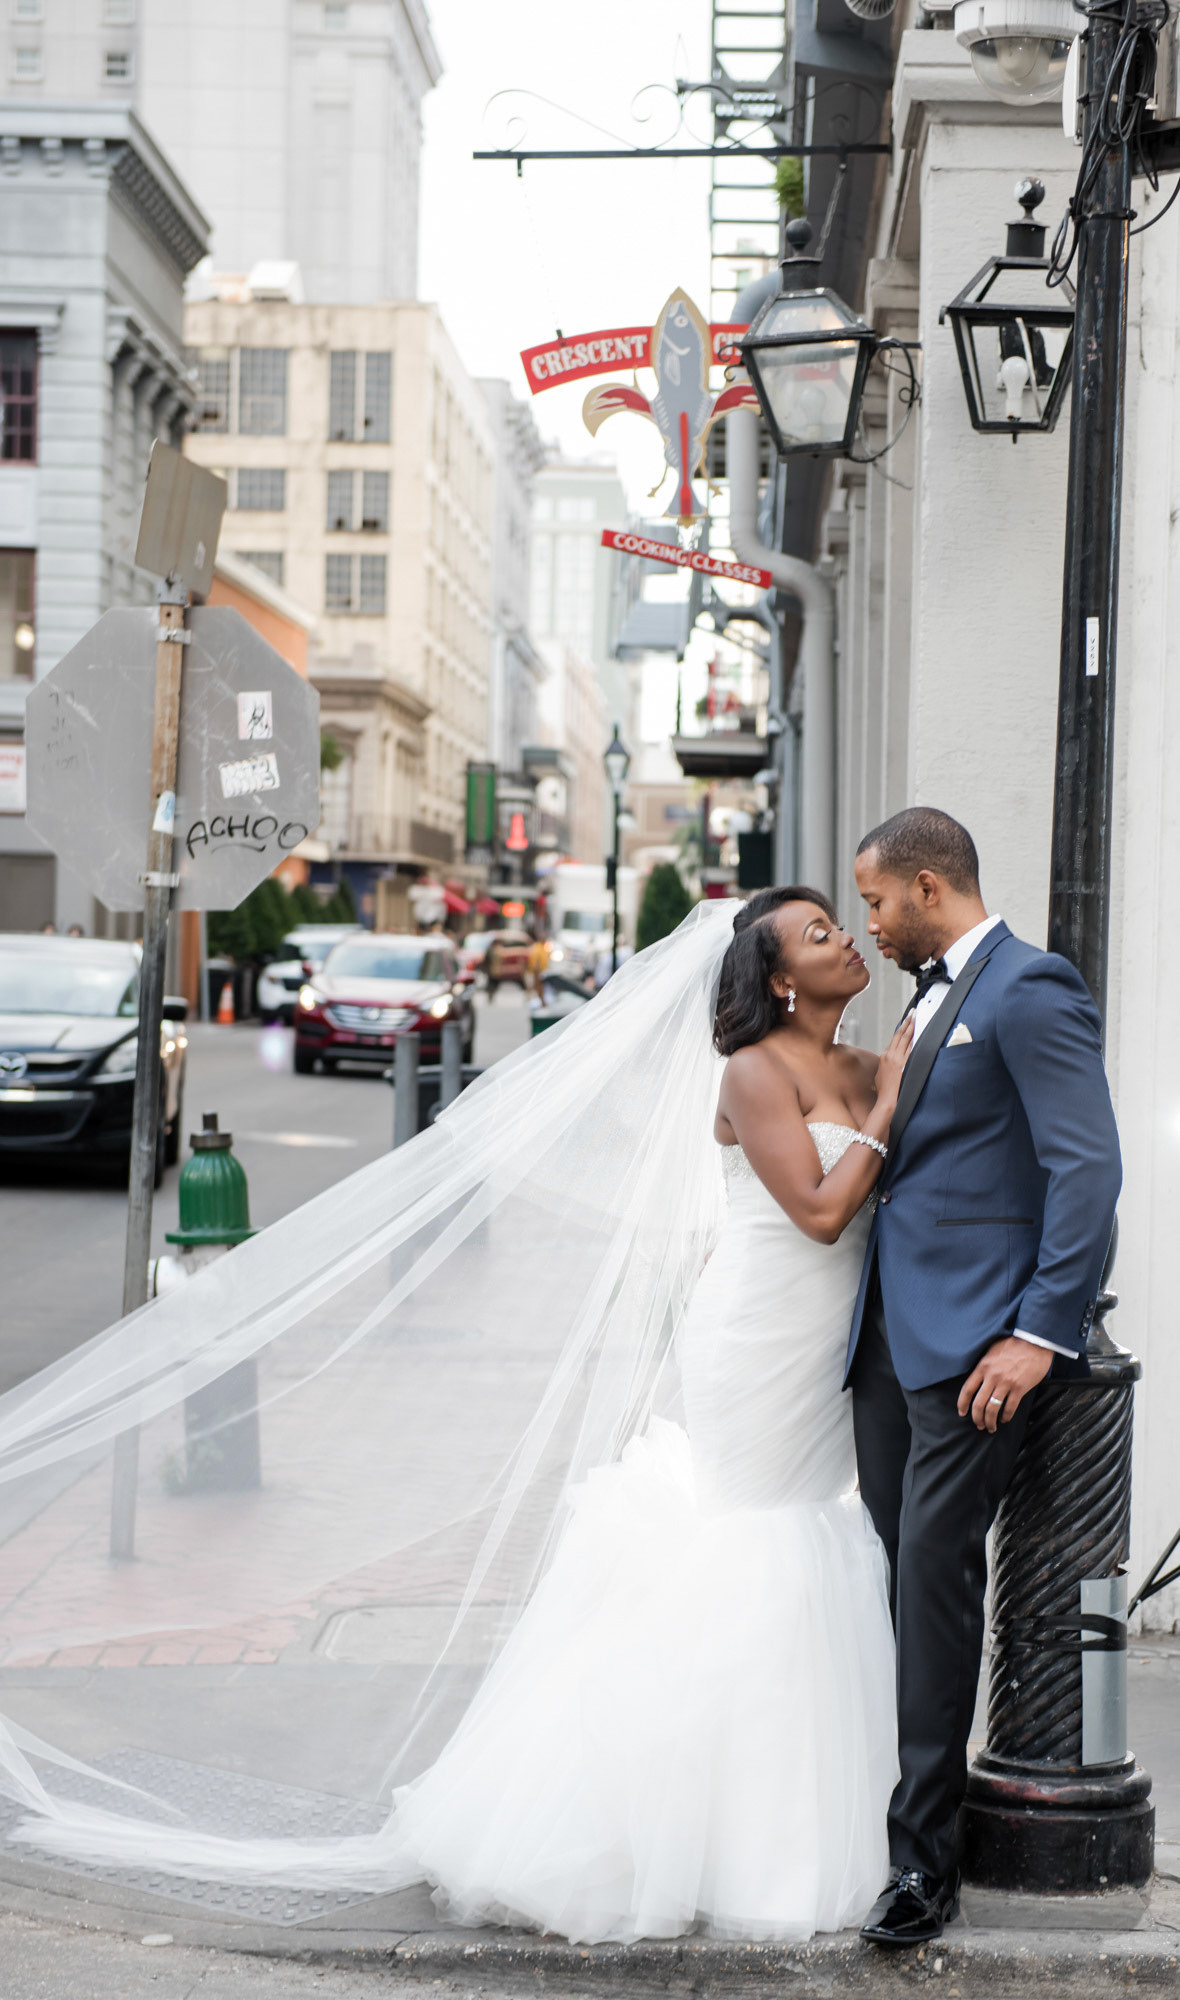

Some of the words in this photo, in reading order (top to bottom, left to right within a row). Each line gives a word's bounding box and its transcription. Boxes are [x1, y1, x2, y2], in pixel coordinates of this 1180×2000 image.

[531, 334, 648, 380] CRESCENT
[713, 332, 746, 356] CIT
[613, 533, 687, 565] COOKING
[692, 554, 761, 585] CLASSES
[186, 815, 308, 859] ACHOO
